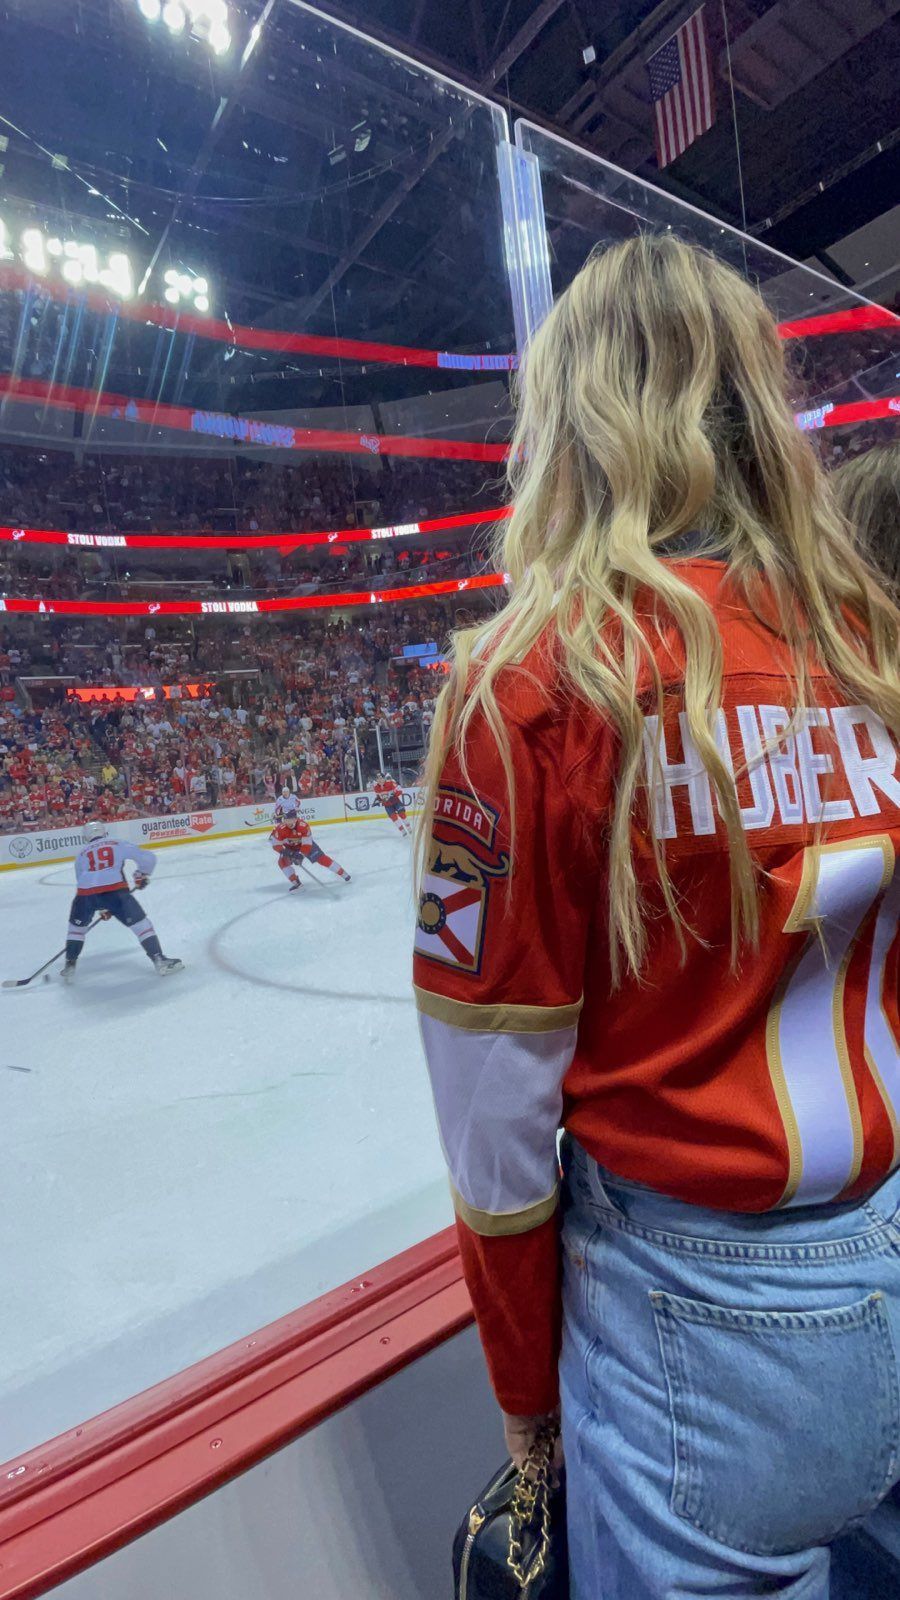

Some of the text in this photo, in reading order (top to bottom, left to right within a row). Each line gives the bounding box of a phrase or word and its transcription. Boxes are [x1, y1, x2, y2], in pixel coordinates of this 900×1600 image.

[371, 523, 420, 539] STOLI VODKA
[67, 534, 127, 546] STOLI VODKA
[201, 601, 258, 613] STOLI VODKA
[142, 815, 213, 835] guaranteed Rate
[87, 846, 114, 872] 19
